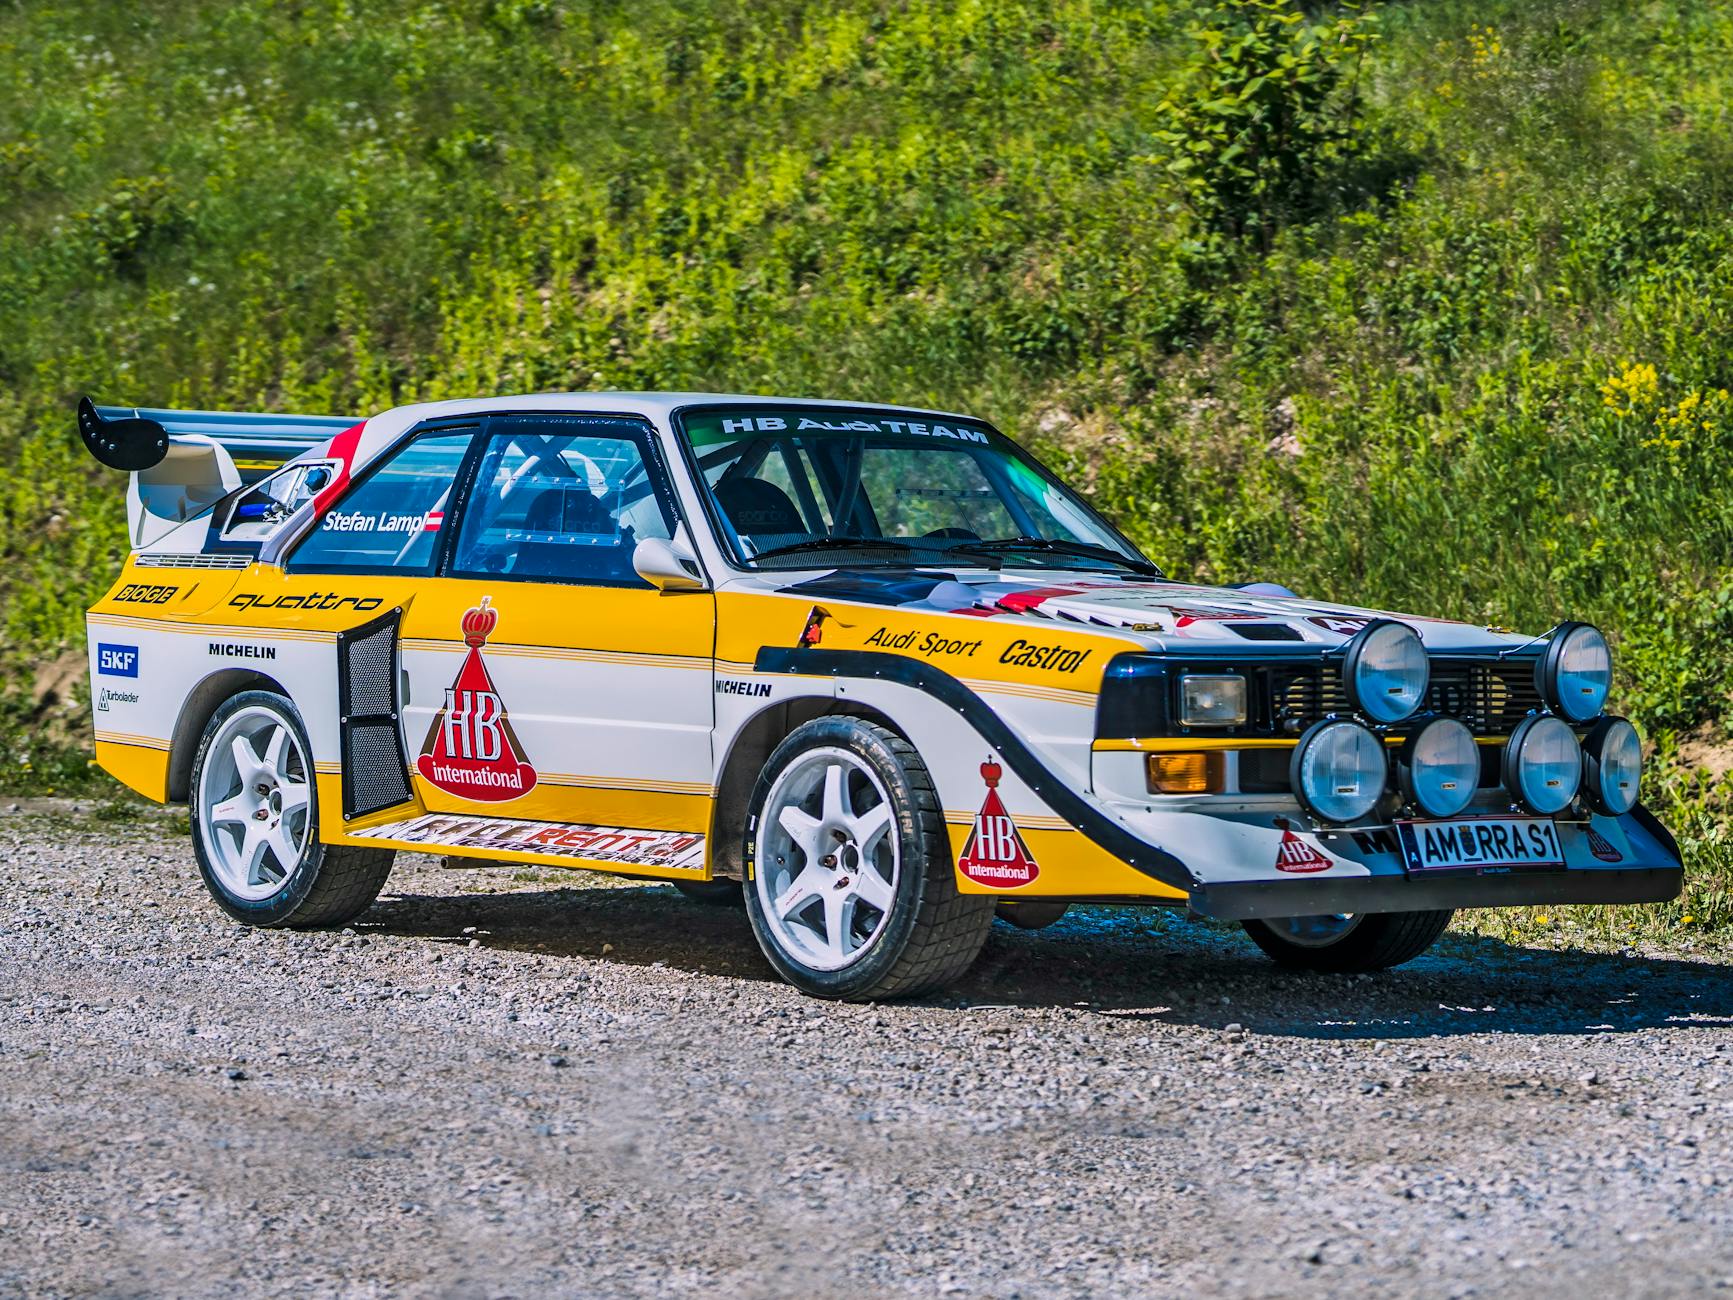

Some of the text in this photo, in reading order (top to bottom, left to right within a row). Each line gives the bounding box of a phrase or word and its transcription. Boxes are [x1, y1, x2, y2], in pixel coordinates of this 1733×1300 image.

[722, 417, 788, 434] HB
[880, 420, 989, 444] TEAM
[322, 511, 430, 536] Stefan Lampl
[115, 585, 177, 604] BOGE
[228, 592, 384, 612] quattro
[209, 643, 276, 660] MICHELIN
[864, 627, 983, 657] Audi Sport
[101, 650, 136, 670] SKF
[998, 639, 1092, 674] Castrol
[106, 689, 139, 703] Turbolader
[715, 680, 772, 698] MICHELIN
[444, 688, 502, 761] HB
[432, 761, 523, 789] international
[524, 828, 658, 852] RENT
[975, 814, 1017, 862] HB
[1424, 824, 1559, 863] AM RRA S1
[1280, 841, 1316, 863] HB
[1410, 852, 1419, 863] A
[967, 862, 1030, 880] international
[1283, 860, 1329, 871] international
